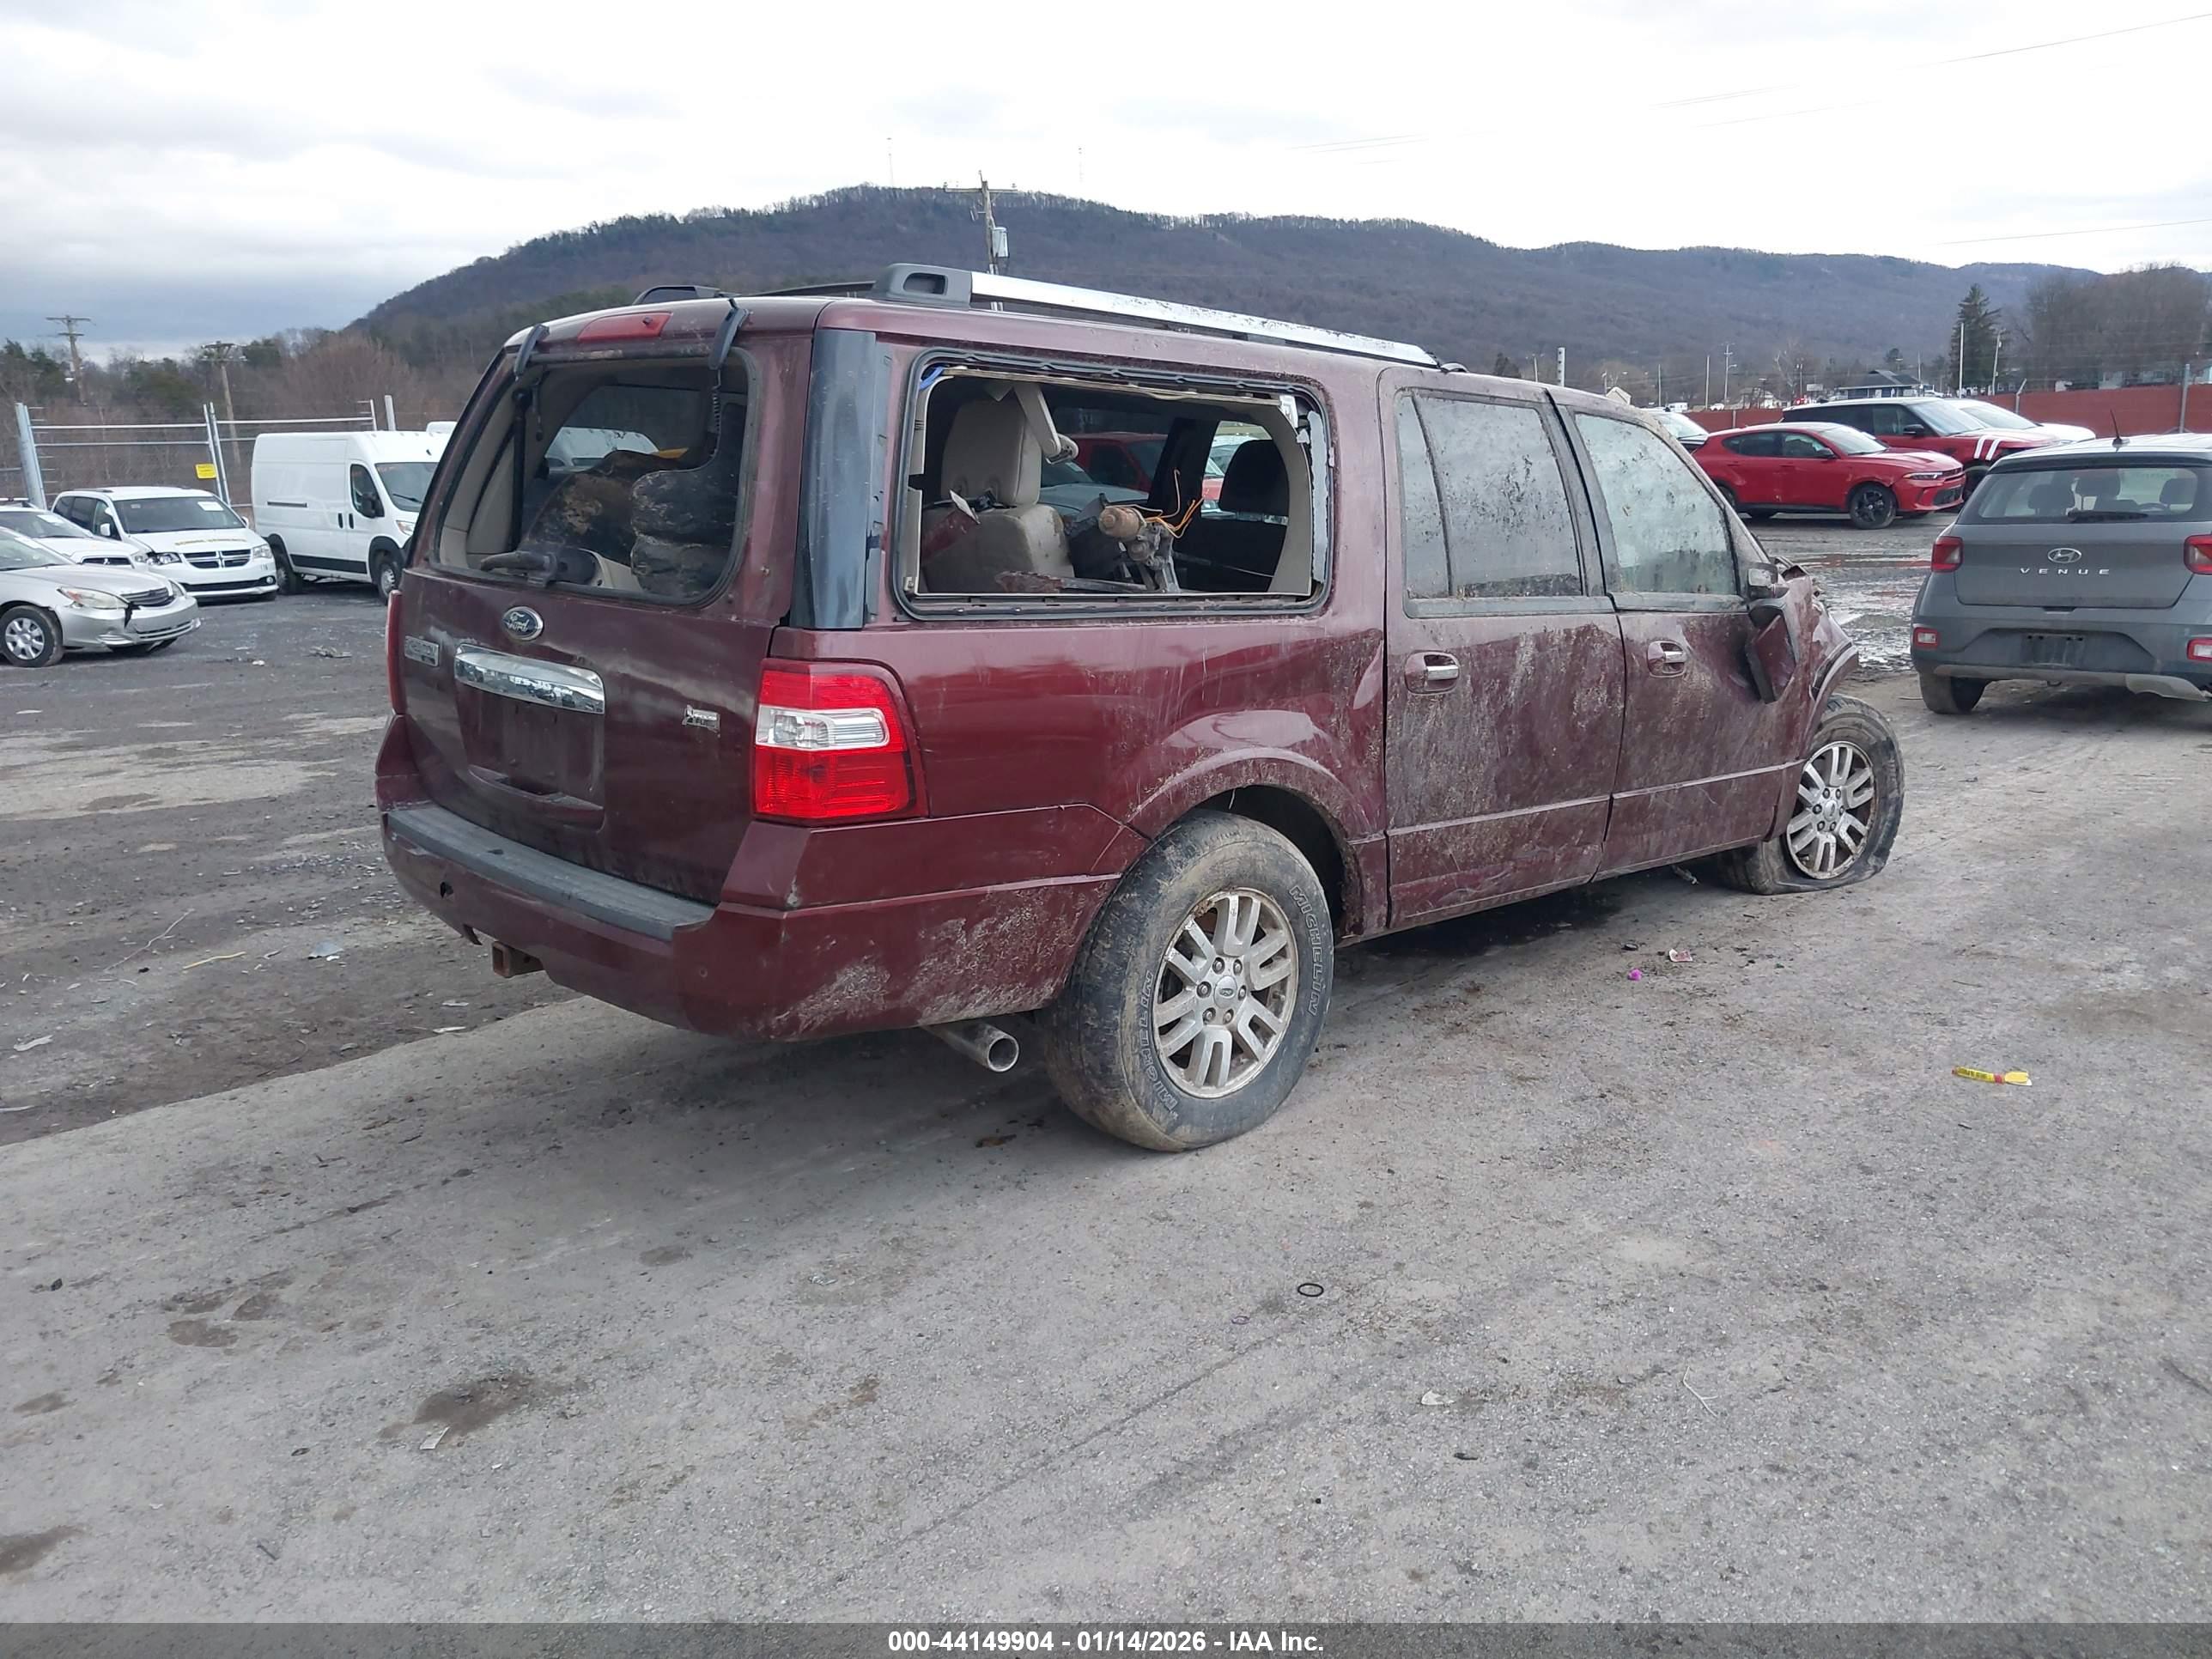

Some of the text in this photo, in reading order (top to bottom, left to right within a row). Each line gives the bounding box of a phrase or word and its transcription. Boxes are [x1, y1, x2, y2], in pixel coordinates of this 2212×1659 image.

[505, 611, 530, 633] Ford
[1290, 885, 1324, 1015] MICHELIN
[1139, 972, 1178, 1111] MICHELIN
